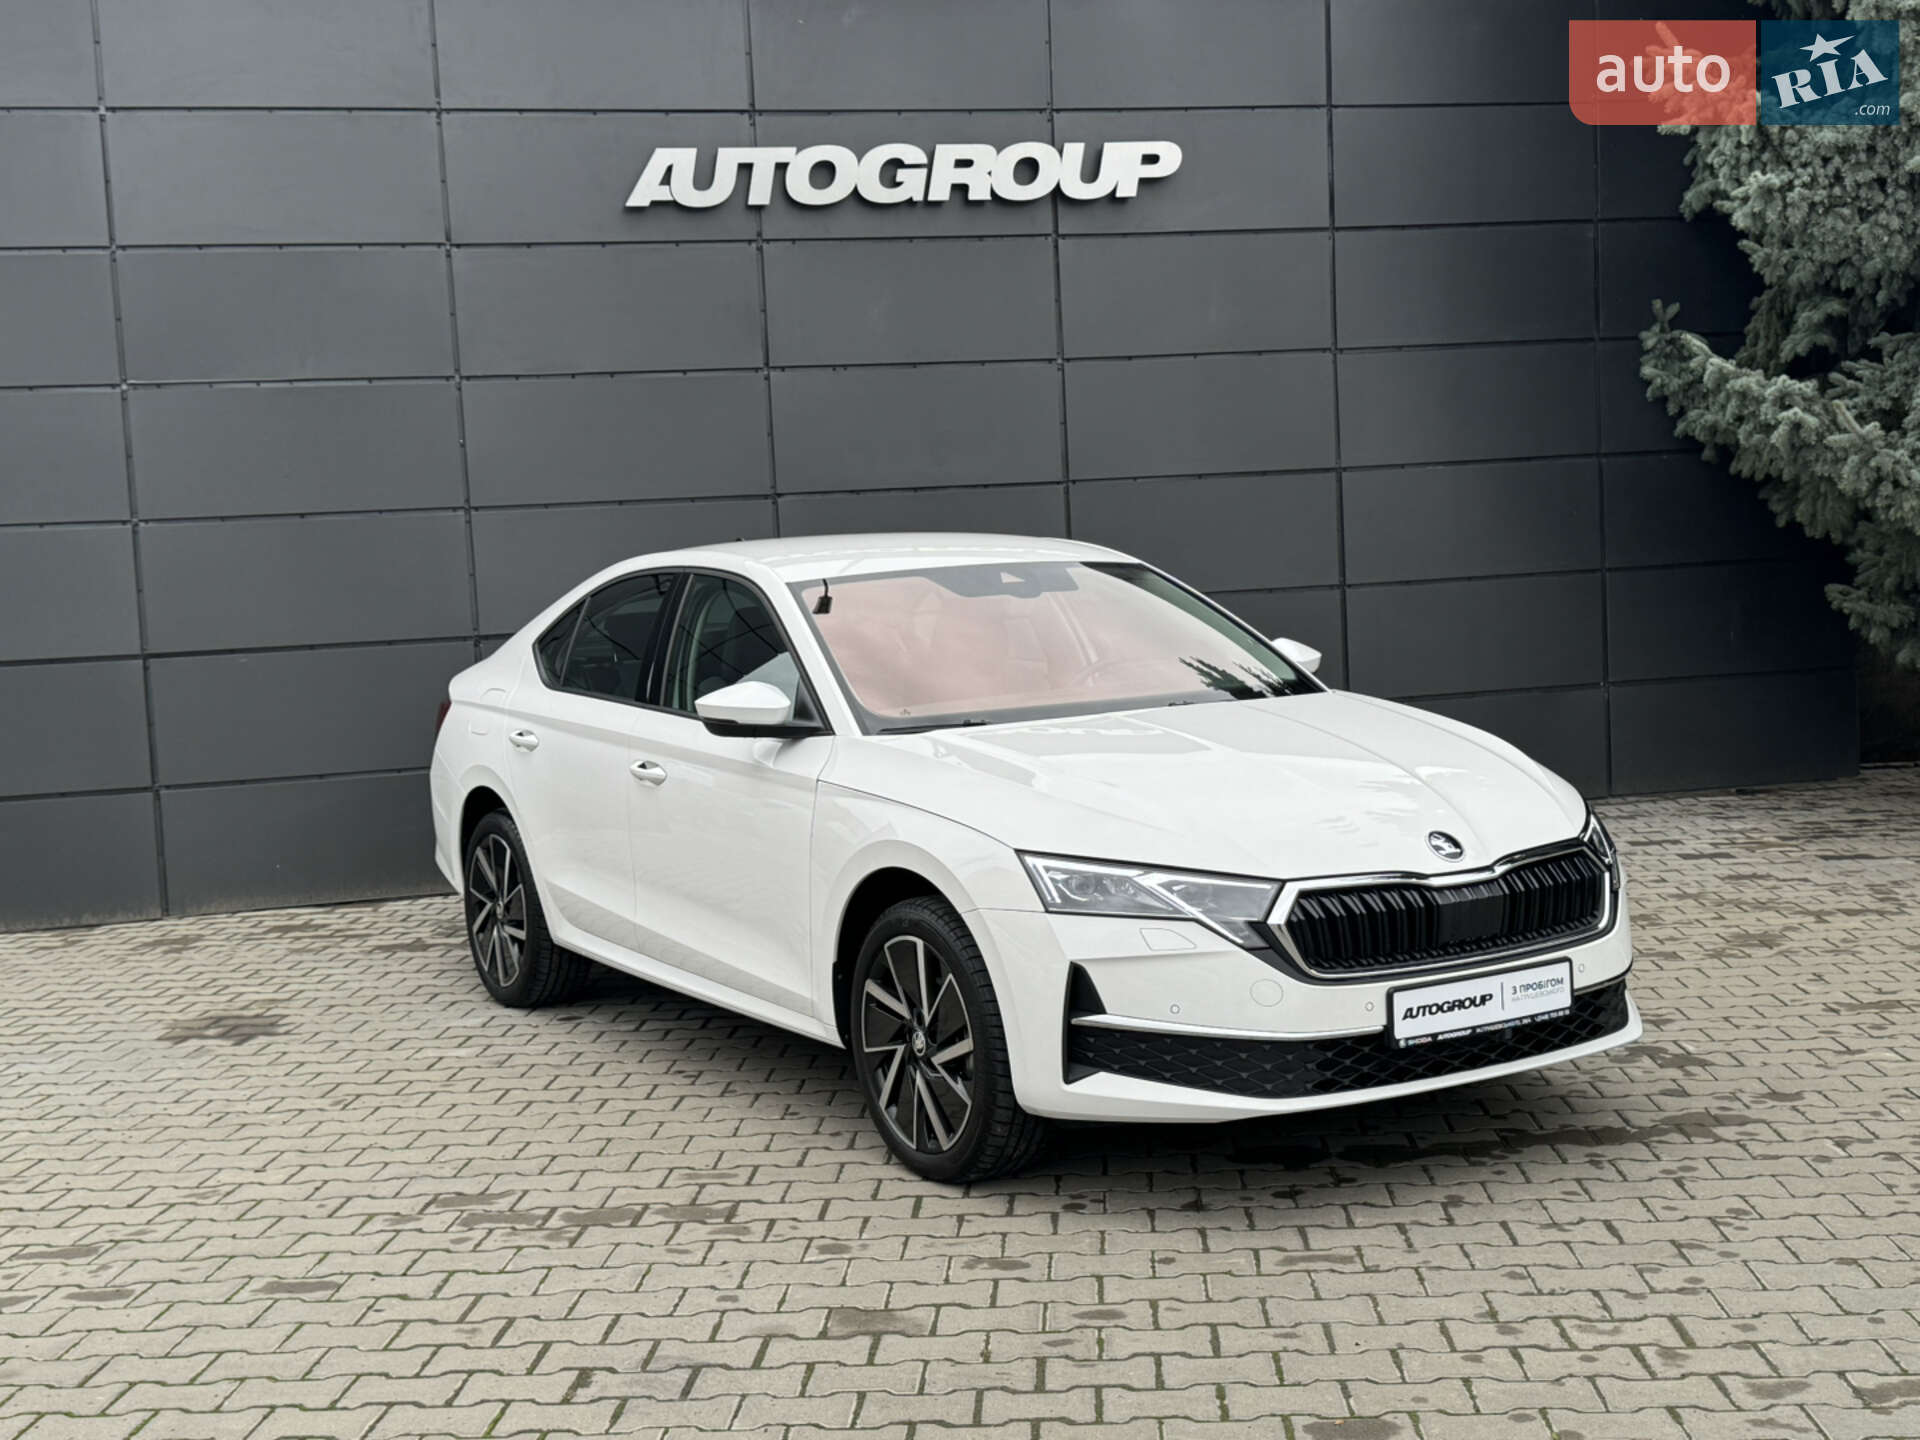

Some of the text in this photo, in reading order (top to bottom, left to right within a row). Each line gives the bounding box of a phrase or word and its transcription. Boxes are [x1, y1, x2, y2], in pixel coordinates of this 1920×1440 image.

[625, 140, 1182, 208] AUTOGROUP
[1519, 978, 1564, 993] ПРОБІГОМ
[1401, 993, 1493, 1021] AUTOGROUP
